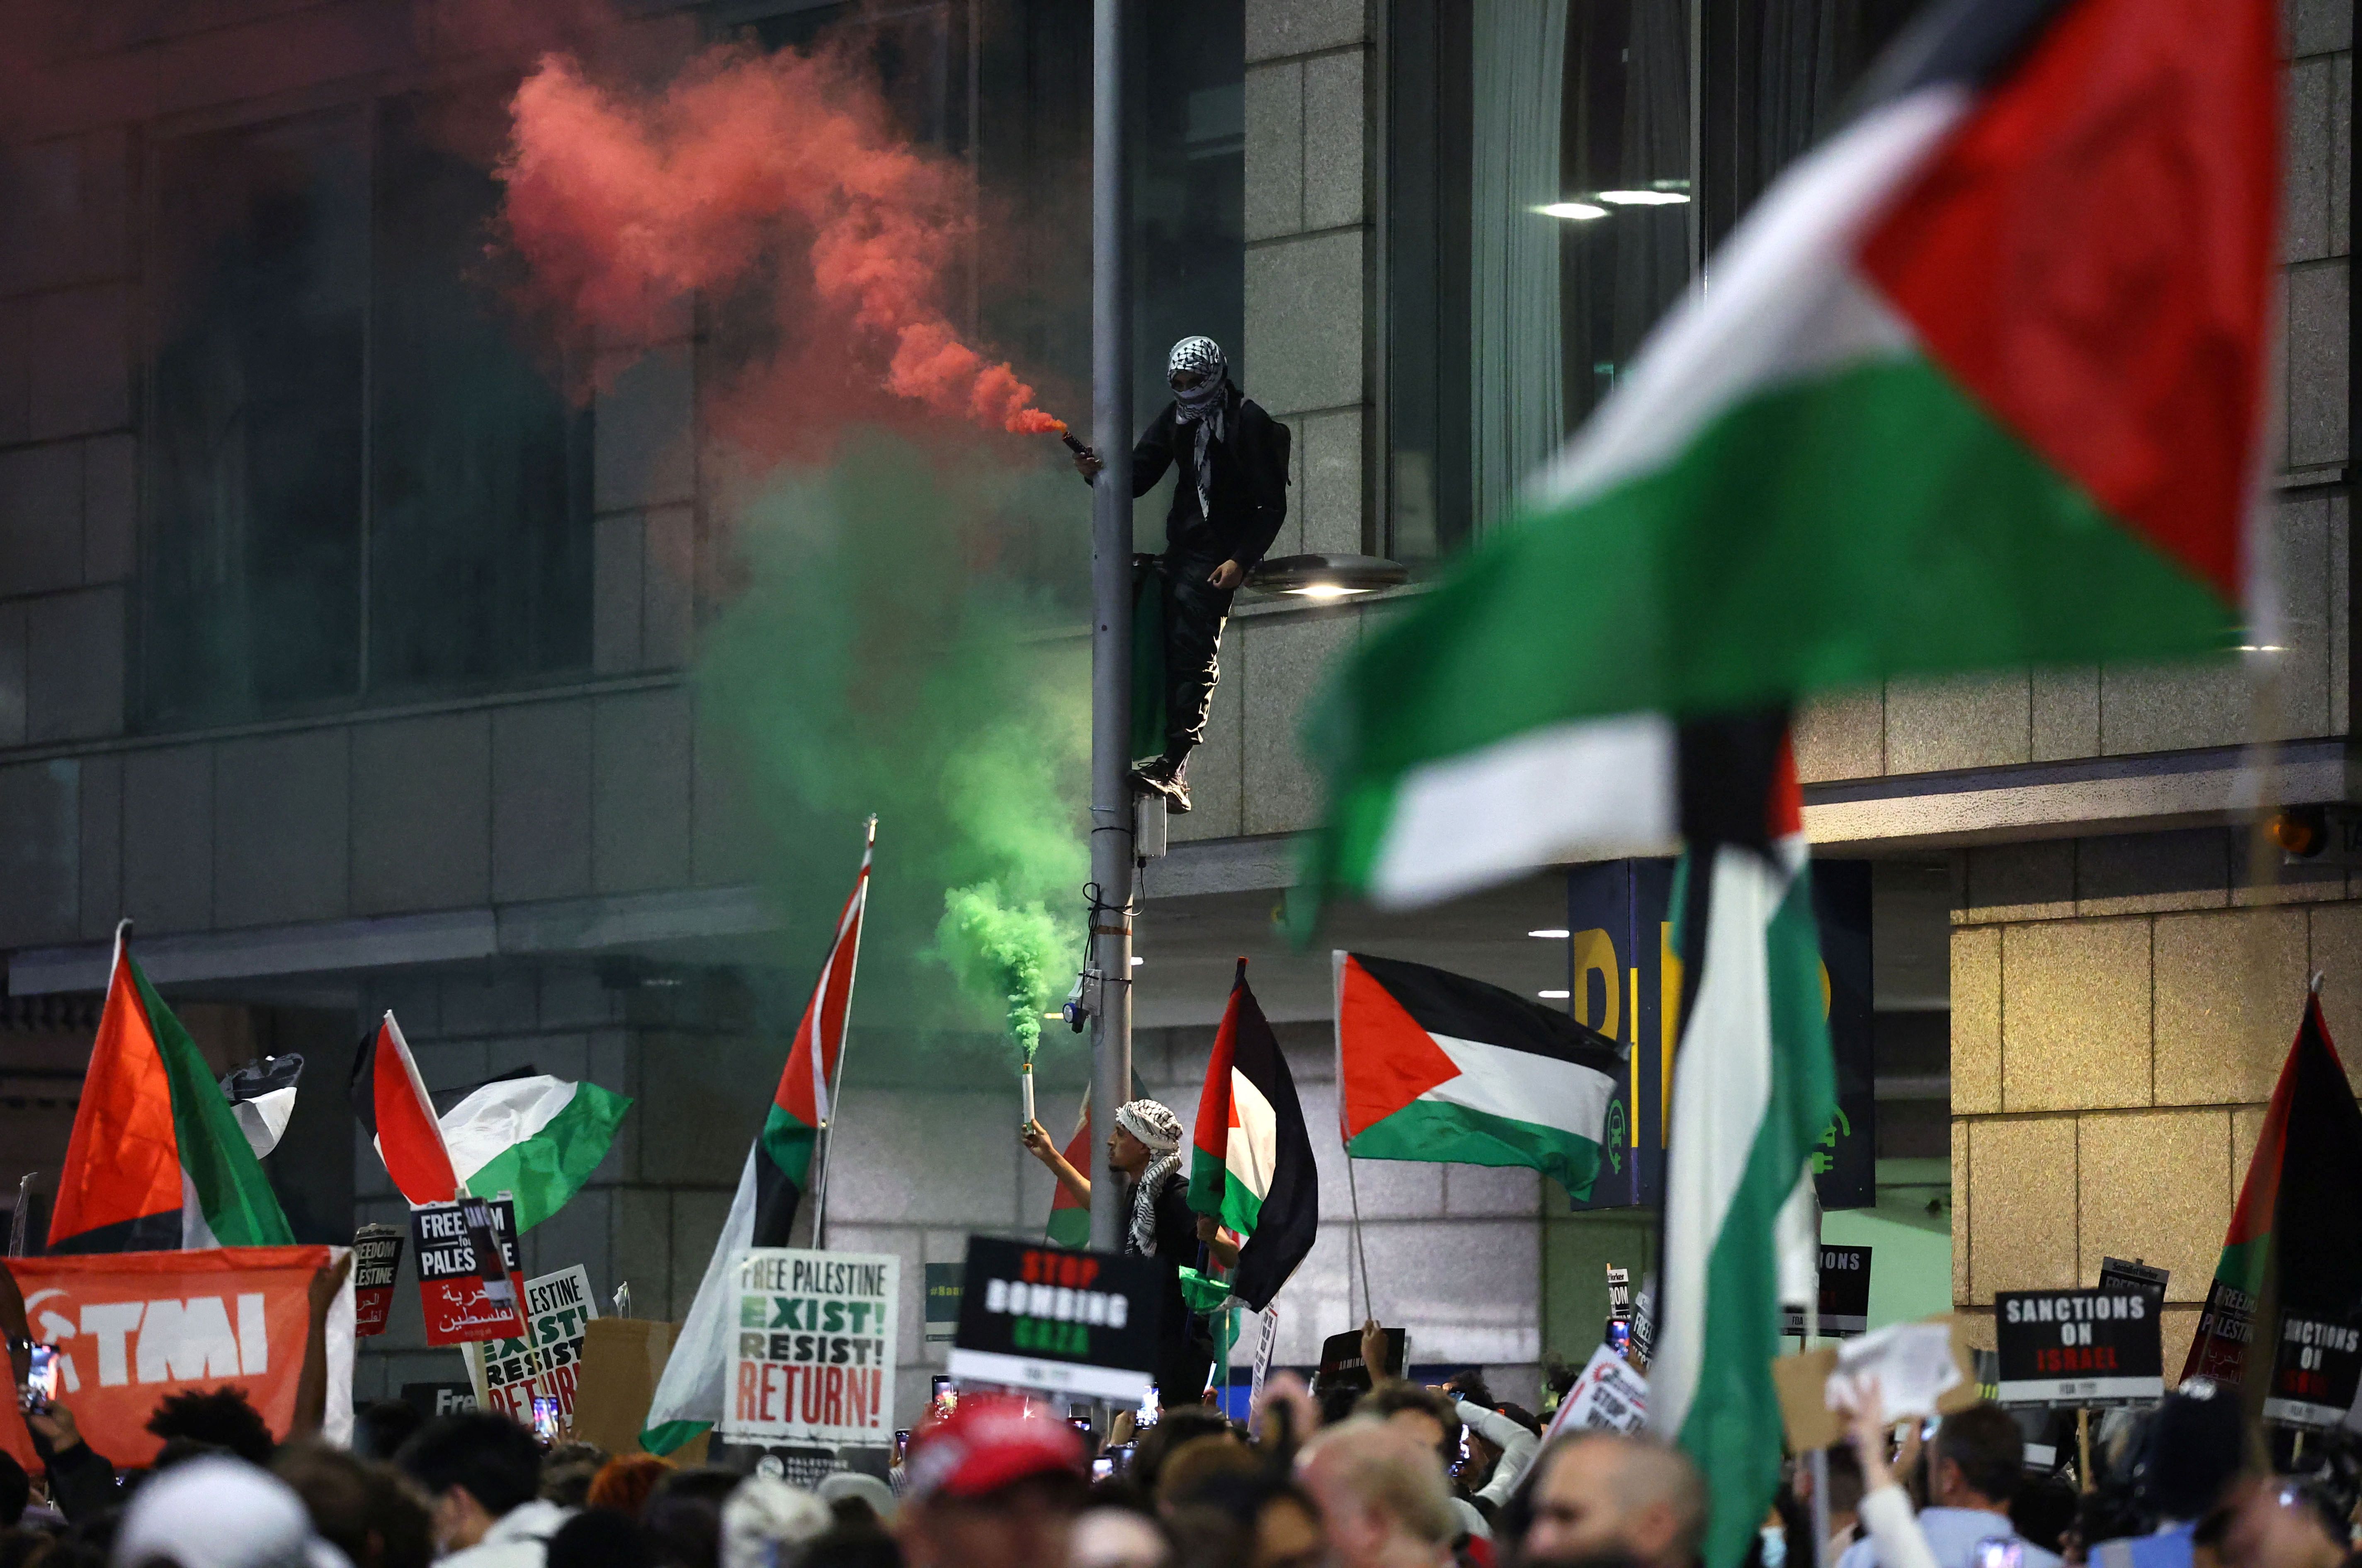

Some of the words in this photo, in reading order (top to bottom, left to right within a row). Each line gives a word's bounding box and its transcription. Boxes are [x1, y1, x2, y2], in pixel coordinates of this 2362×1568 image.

[421, 1207, 505, 1239] FREEM
[421, 1243, 514, 1275] PALESE
[742, 1257, 787, 1291] FREE
[793, 1259, 886, 1297] PALESTINE
[1022, 1250, 1100, 1289] STOP
[527, 1275, 583, 1317] ESTINE
[740, 1296, 886, 1335] EXIST!
[985, 1277, 1129, 1329] BOMBING
[2006, 1295, 2145, 1323] SANCTIONS
[740, 1332, 884, 1365] RESIST!
[1013, 1316, 1090, 1356] GAZA
[2061, 1322, 2092, 1346] ON
[2037, 1347, 2119, 1372] ISRAEL
[736, 1360, 882, 1428] RETURN!
